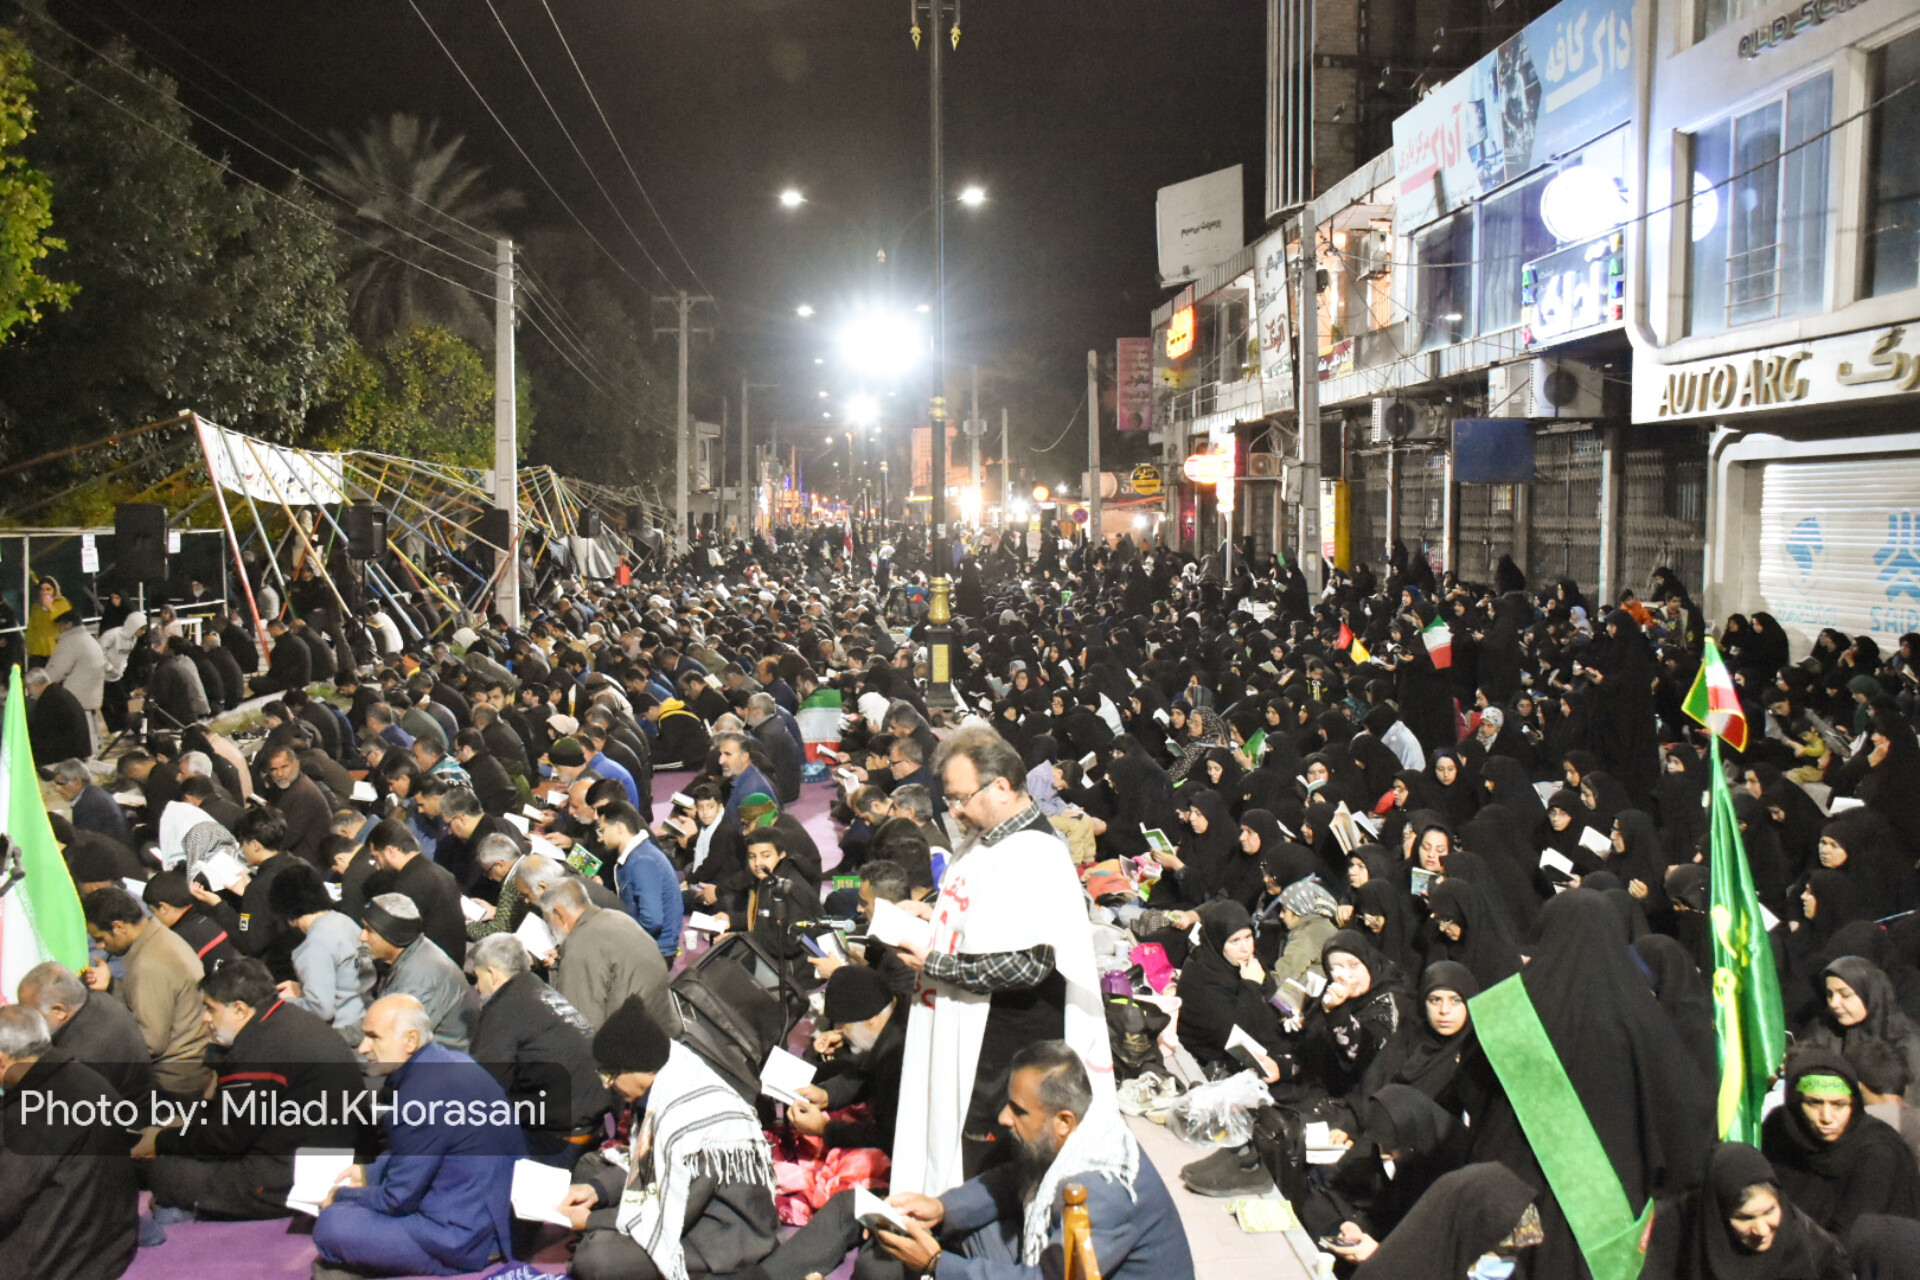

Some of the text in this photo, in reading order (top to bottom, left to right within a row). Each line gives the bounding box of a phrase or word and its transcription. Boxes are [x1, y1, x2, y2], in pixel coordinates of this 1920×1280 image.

[1546, 10, 1590, 83] کافه
[1738, 15, 1792, 58] OLD
[1658, 350, 1814, 417] AUTO ARG
